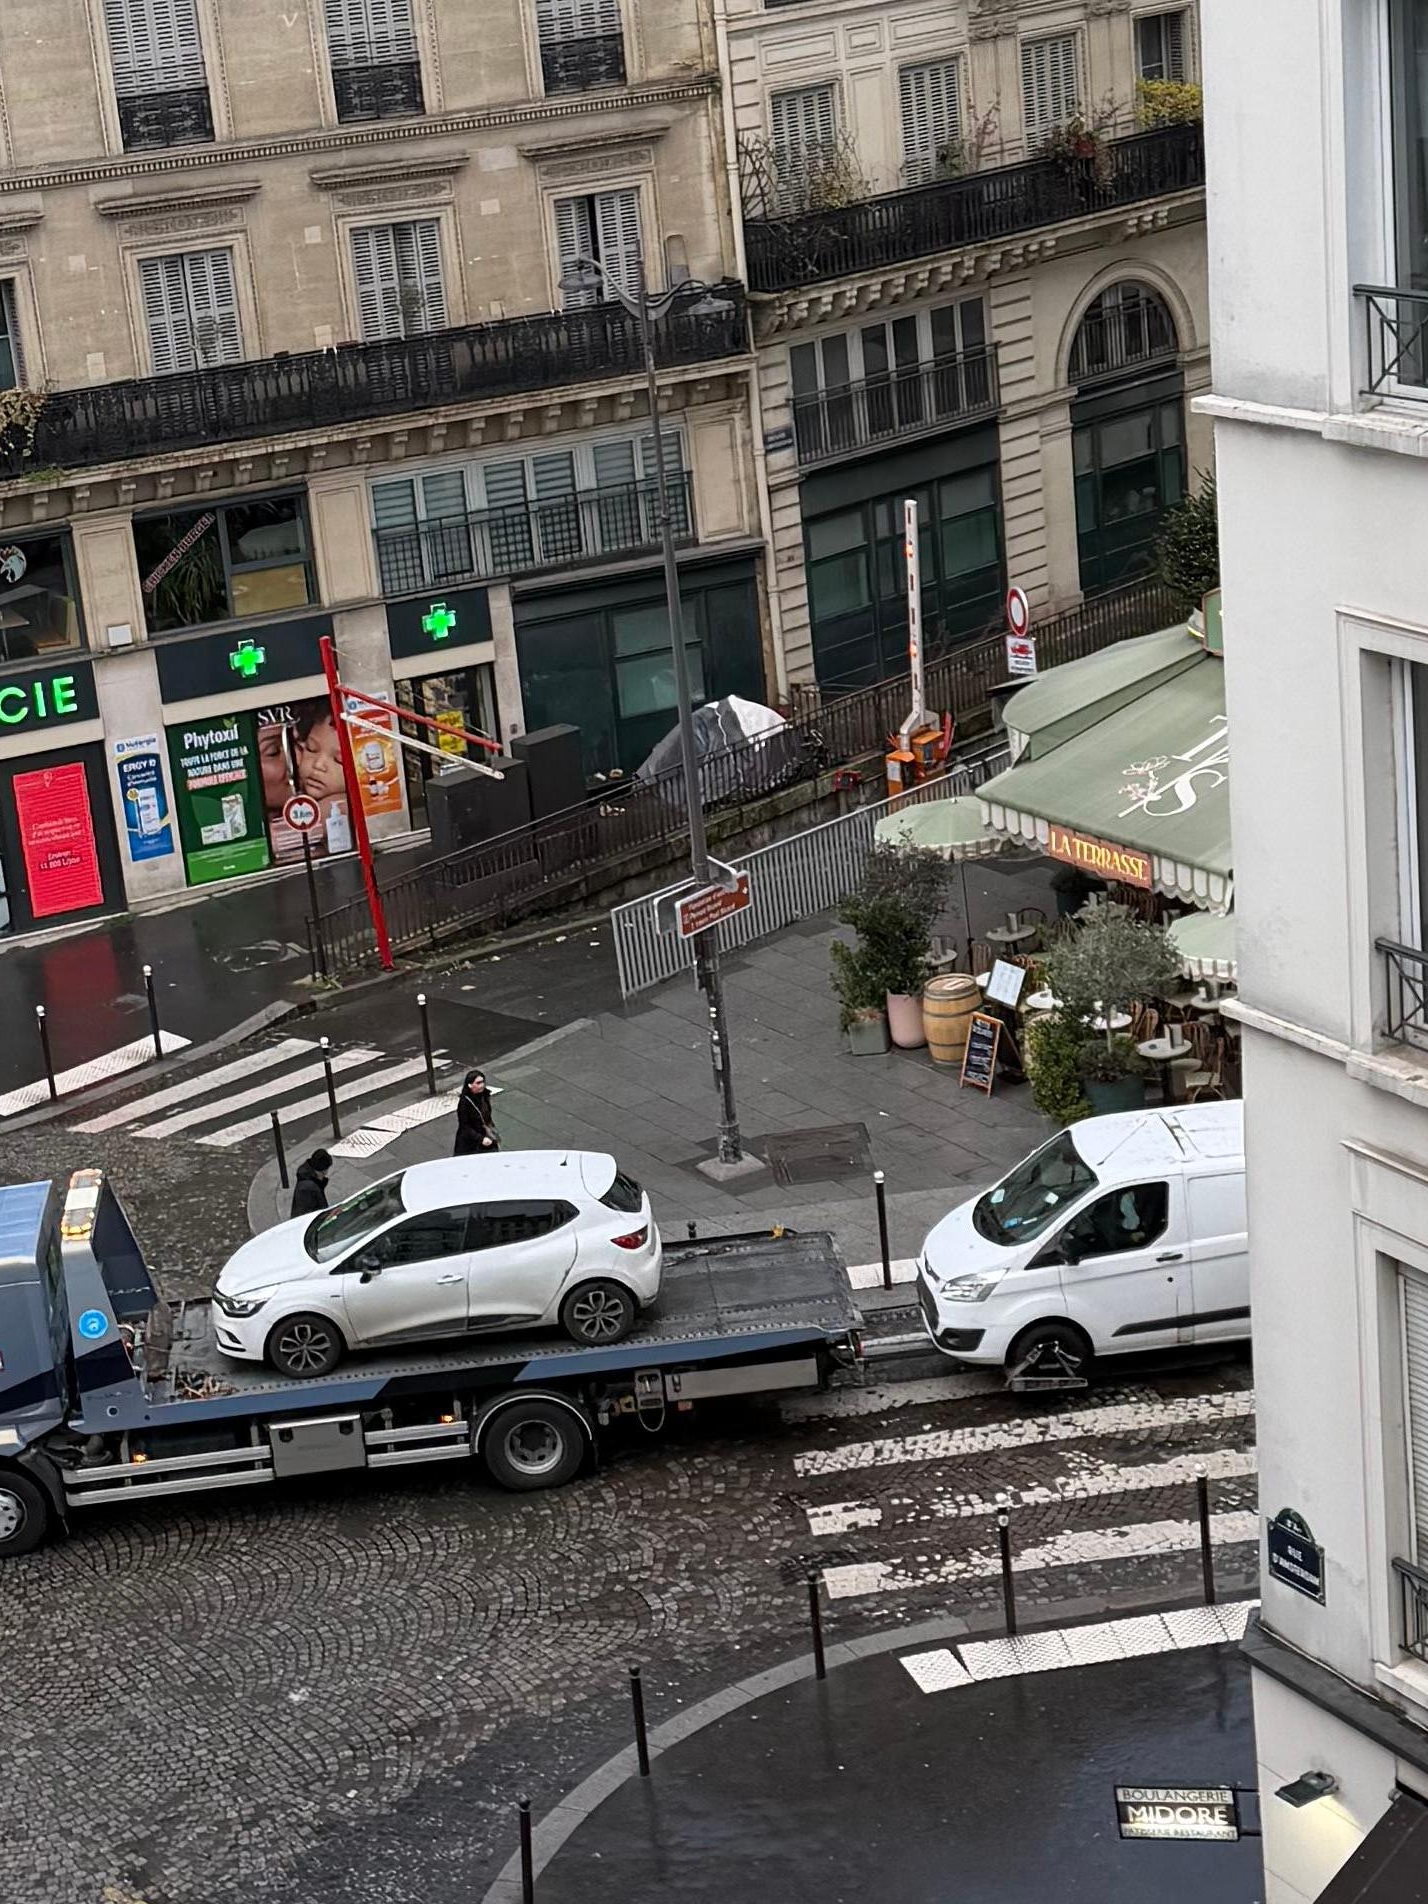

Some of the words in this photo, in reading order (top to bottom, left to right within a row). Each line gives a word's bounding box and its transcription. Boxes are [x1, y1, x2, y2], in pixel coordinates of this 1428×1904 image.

[257, 705, 295, 727] SVR
[183, 723, 239, 750] Phytoxil
[1051, 831, 1072, 856] LA
[1073, 839, 1149, 881] TERRASSE
[1122, 1789, 1229, 1802] BOULANGERIE
